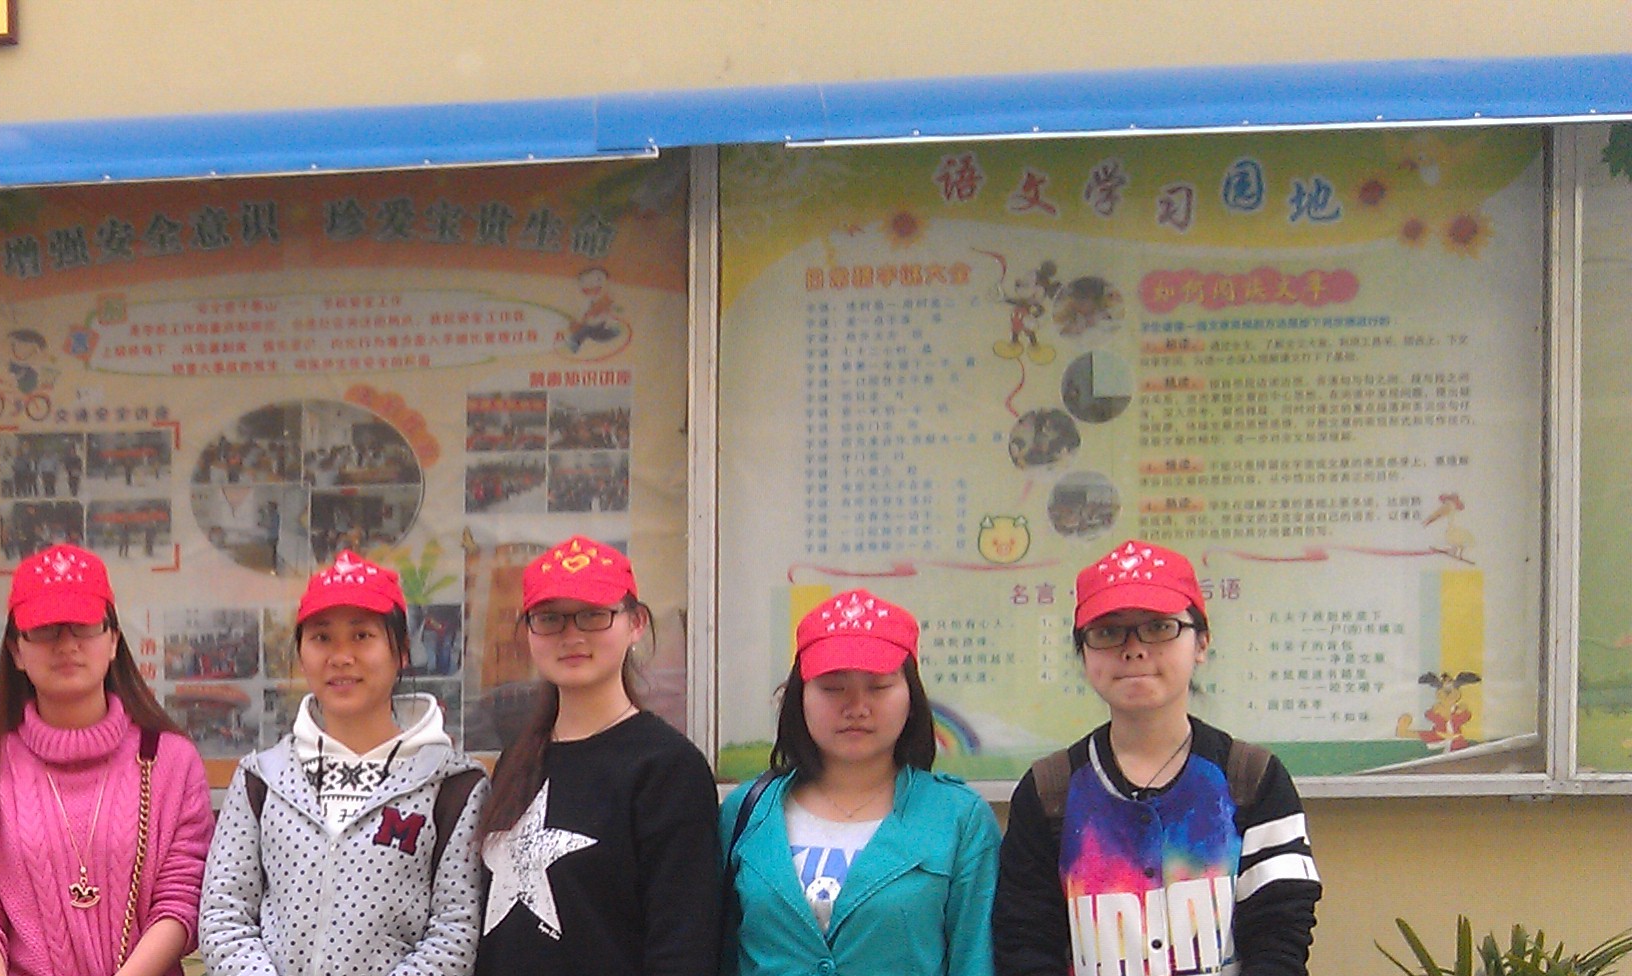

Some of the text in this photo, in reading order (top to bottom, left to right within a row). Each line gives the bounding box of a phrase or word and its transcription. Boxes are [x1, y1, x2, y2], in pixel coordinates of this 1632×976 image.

[934, 151, 1342, 232] 语文学习园地
[0, 197, 621, 279] 增强安全意识 珍爱宝贵生命
[1011, 582, 1057, 604] 名言
[372, 805, 427, 856] M
